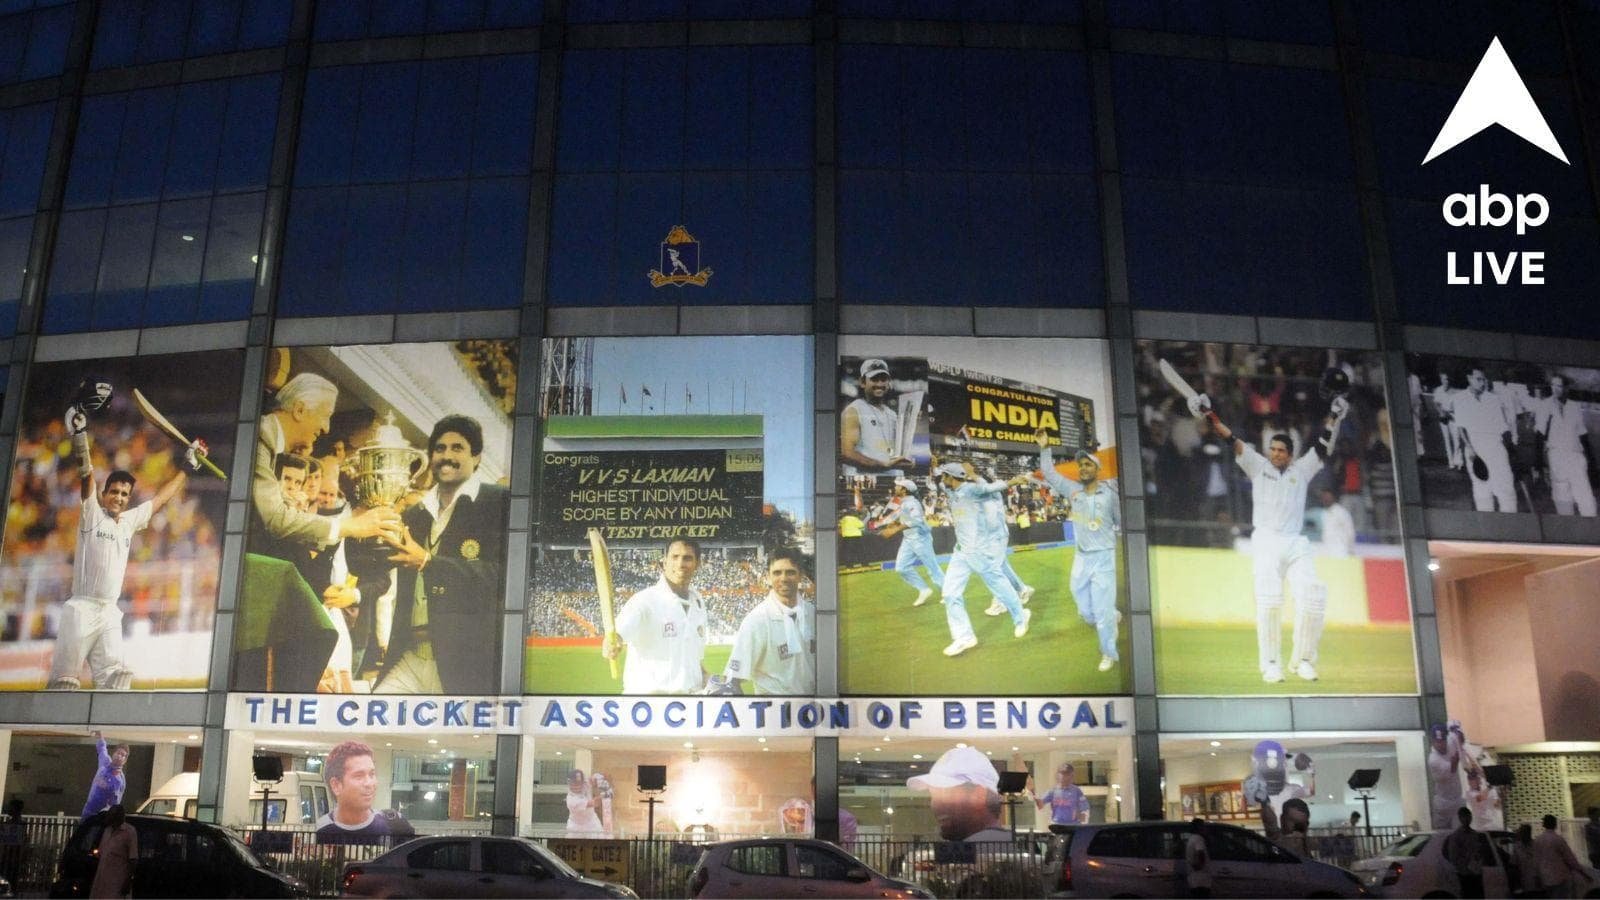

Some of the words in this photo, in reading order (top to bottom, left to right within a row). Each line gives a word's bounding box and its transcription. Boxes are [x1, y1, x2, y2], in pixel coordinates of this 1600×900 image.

[970, 398, 1059, 431] INDIA
[544, 453, 600, 467] Congrats
[579, 469, 596, 485] V
[597, 469, 613, 485] V
[613, 468, 629, 485] S
[631, 467, 716, 484] LAXMAN
[570, 489, 640, 503] HIGHEST
[642, 488, 729, 502] INDIVIDUAL
[562, 508, 616, 521] SCORE
[620, 508, 642, 520] BY
[643, 507, 677, 519] ANY
[681, 506, 733, 519] INDIAN
[607, 526, 647, 538] TEST
[649, 525, 719, 538] CRICKET
[246, 698, 319, 725] THE
[336, 699, 522, 728] CRICKET
[540, 700, 852, 729] ASSOCIATION
[867, 701, 923, 729] OF
[944, 701, 1127, 729] BENGAL
[592, 846, 615, 862] GATE
[616, 846, 622, 862] 2
